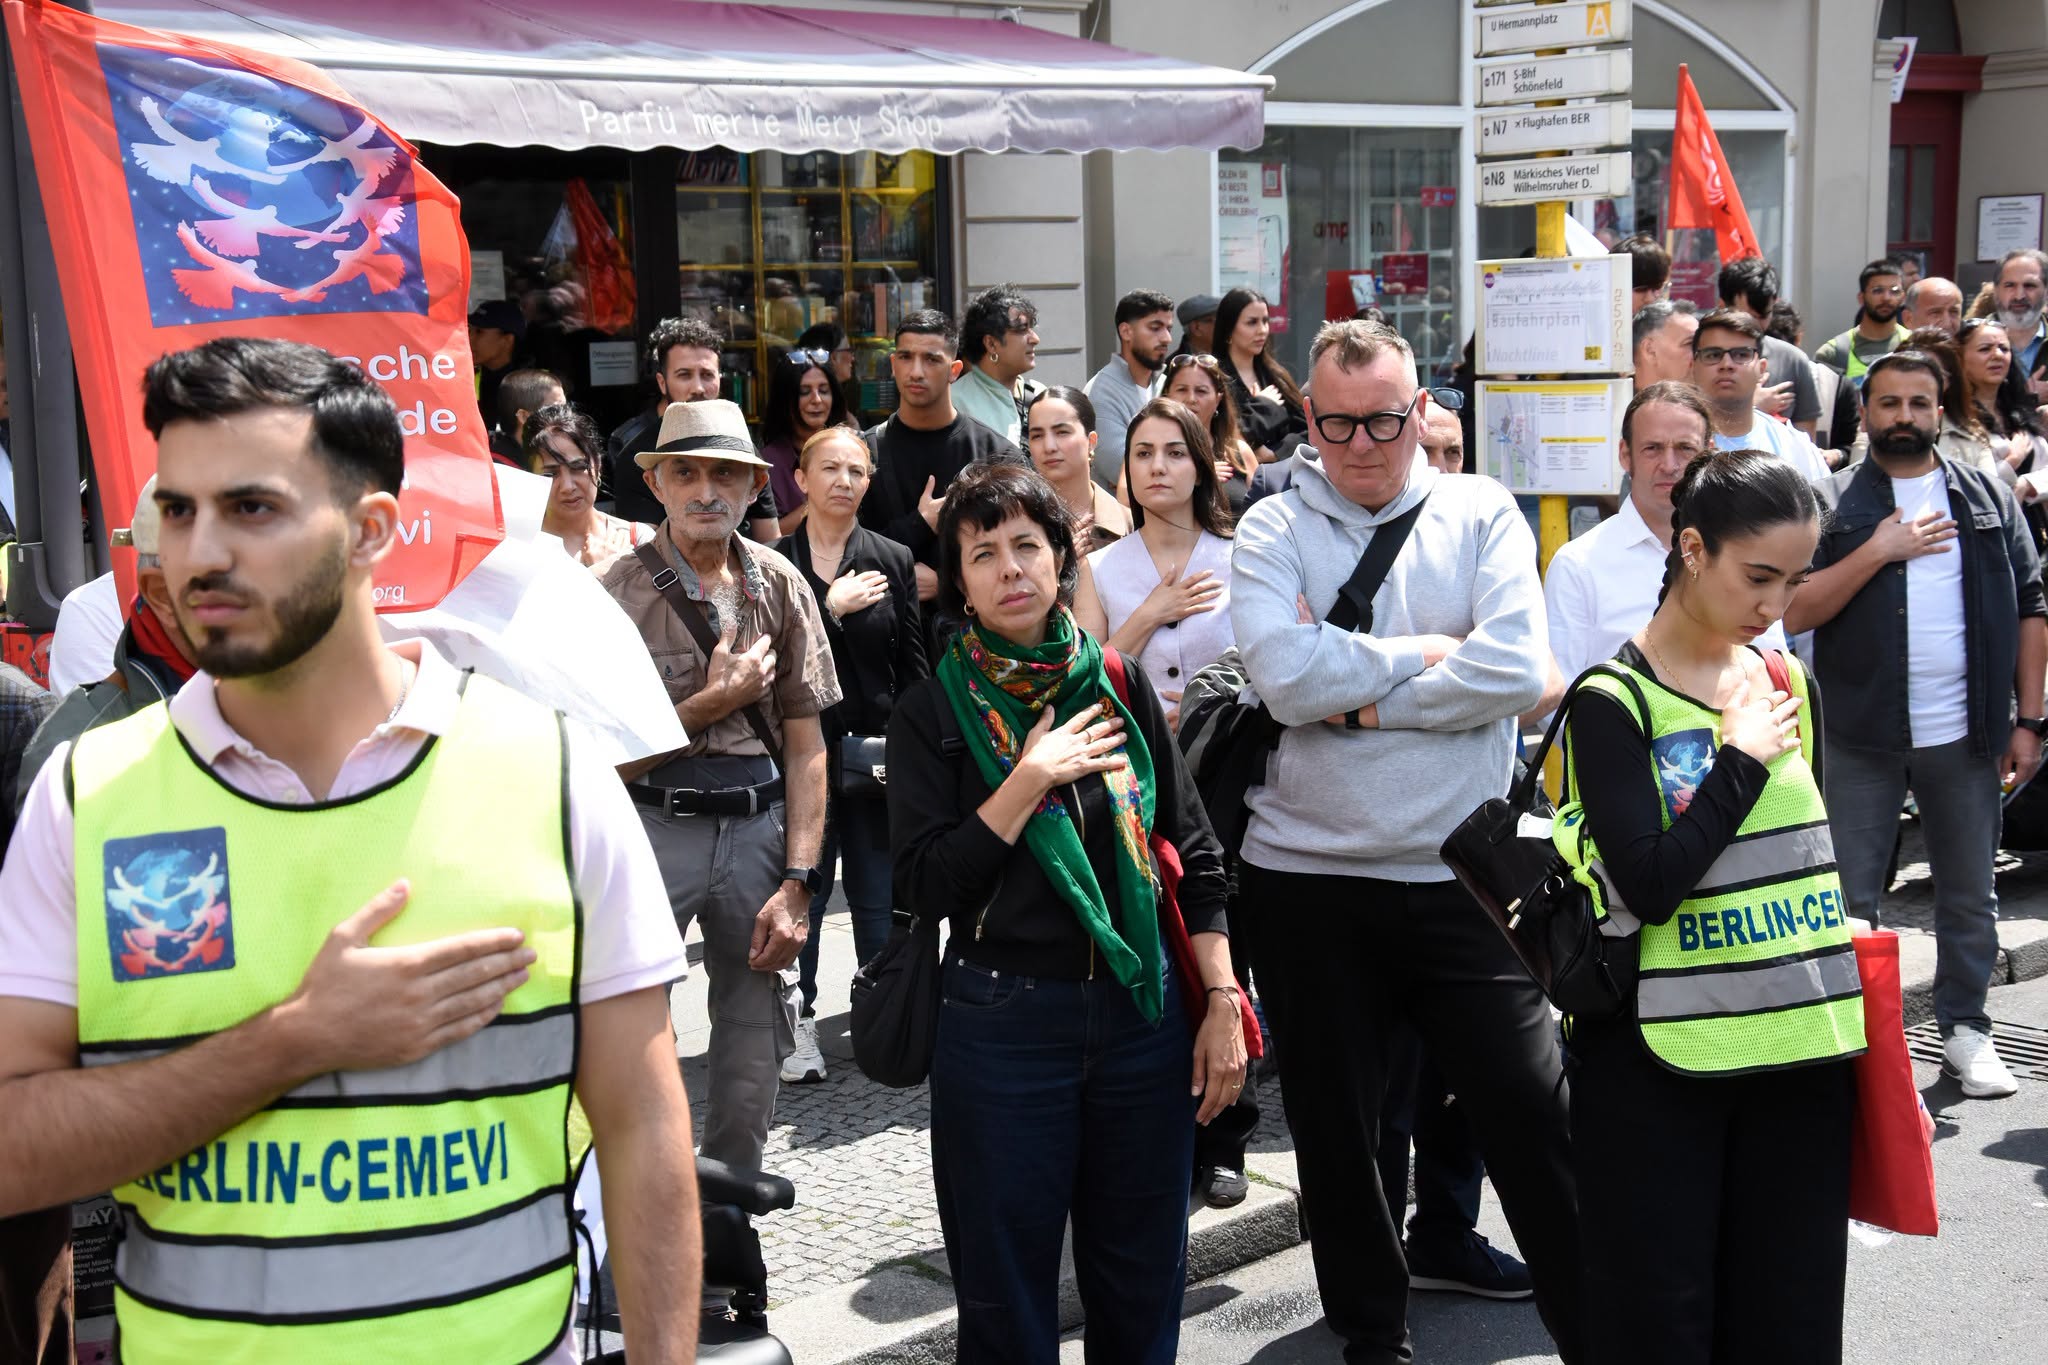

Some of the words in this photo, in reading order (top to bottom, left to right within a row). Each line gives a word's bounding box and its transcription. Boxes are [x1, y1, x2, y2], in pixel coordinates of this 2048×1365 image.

[1491, 20, 1497, 32] U
[1498, 13, 1559, 31] Hermannplatz
[1588, 6, 1611, 37] A
[1490, 70, 1506, 86] 171
[1513, 67, 1537, 81] S-Bhf
[1513, 78, 1563, 94] Schönefeld
[579, 100, 677, 137] Parfü
[691, 104, 781, 138] merie
[797, 104, 863, 144] Mery
[878, 103, 943, 143] Shop
[1493, 120, 1507, 135] N7
[1522, 114, 1568, 130] Flughafen
[1571, 112, 1591, 125] BER
[1490, 171, 1506, 186] N8
[1513, 167, 1563, 180] Märkisches
[1565, 163, 1600, 177] Viertel
[1513, 178, 1579, 193] Wilhelmsruher
[1582, 178, 1593, 190] D.
[1491, 312, 1581, 330] Baufahrplan
